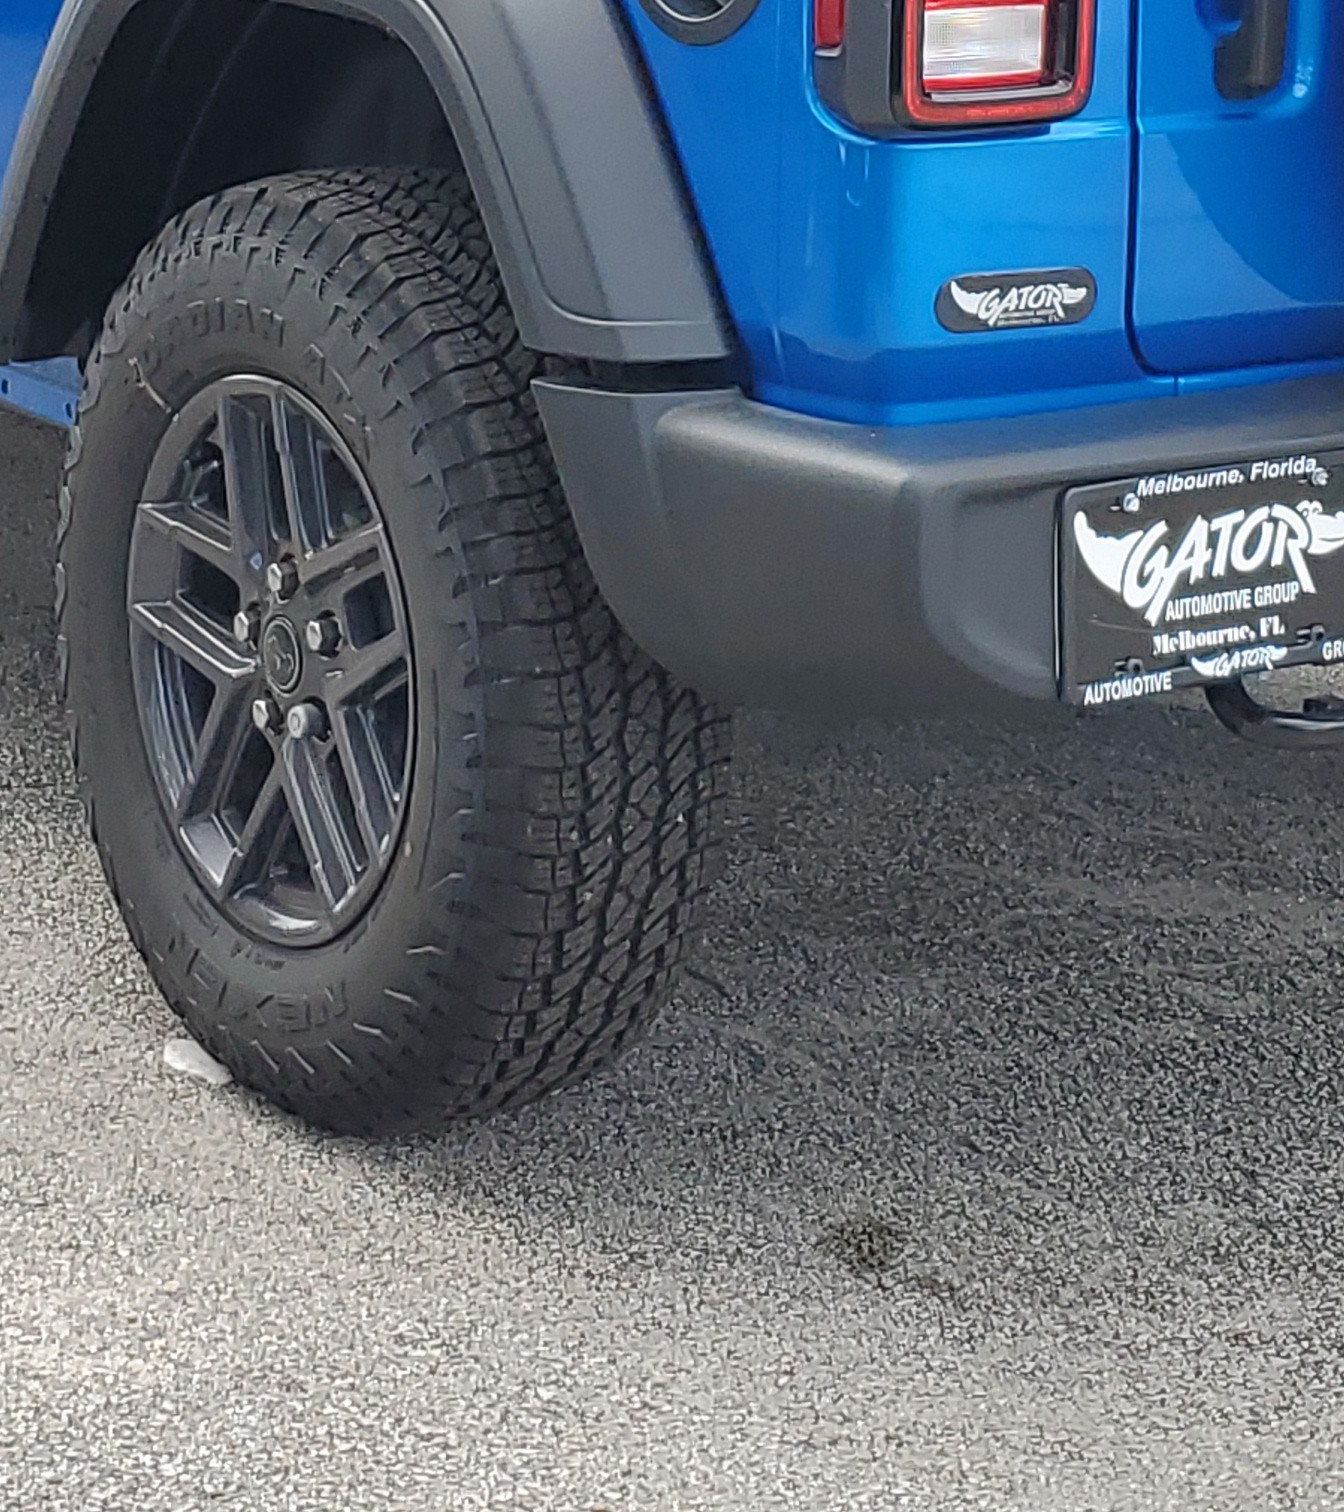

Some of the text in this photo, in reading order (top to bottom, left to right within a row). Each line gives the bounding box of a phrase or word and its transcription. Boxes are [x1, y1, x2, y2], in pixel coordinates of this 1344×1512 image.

[978, 283, 1066, 327] GATOR
[1137, 455, 1317, 497] Melbourne, Florida
[1121, 503, 1317, 626] GATOR
[1165, 581, 1300, 622] AUTOMOTIVE GROUP
[1153, 623, 1256, 656] Melbourne,
[1083, 670, 1173, 706] AUTOMOTIVE
[1215, 645, 1274, 677] GATOR
